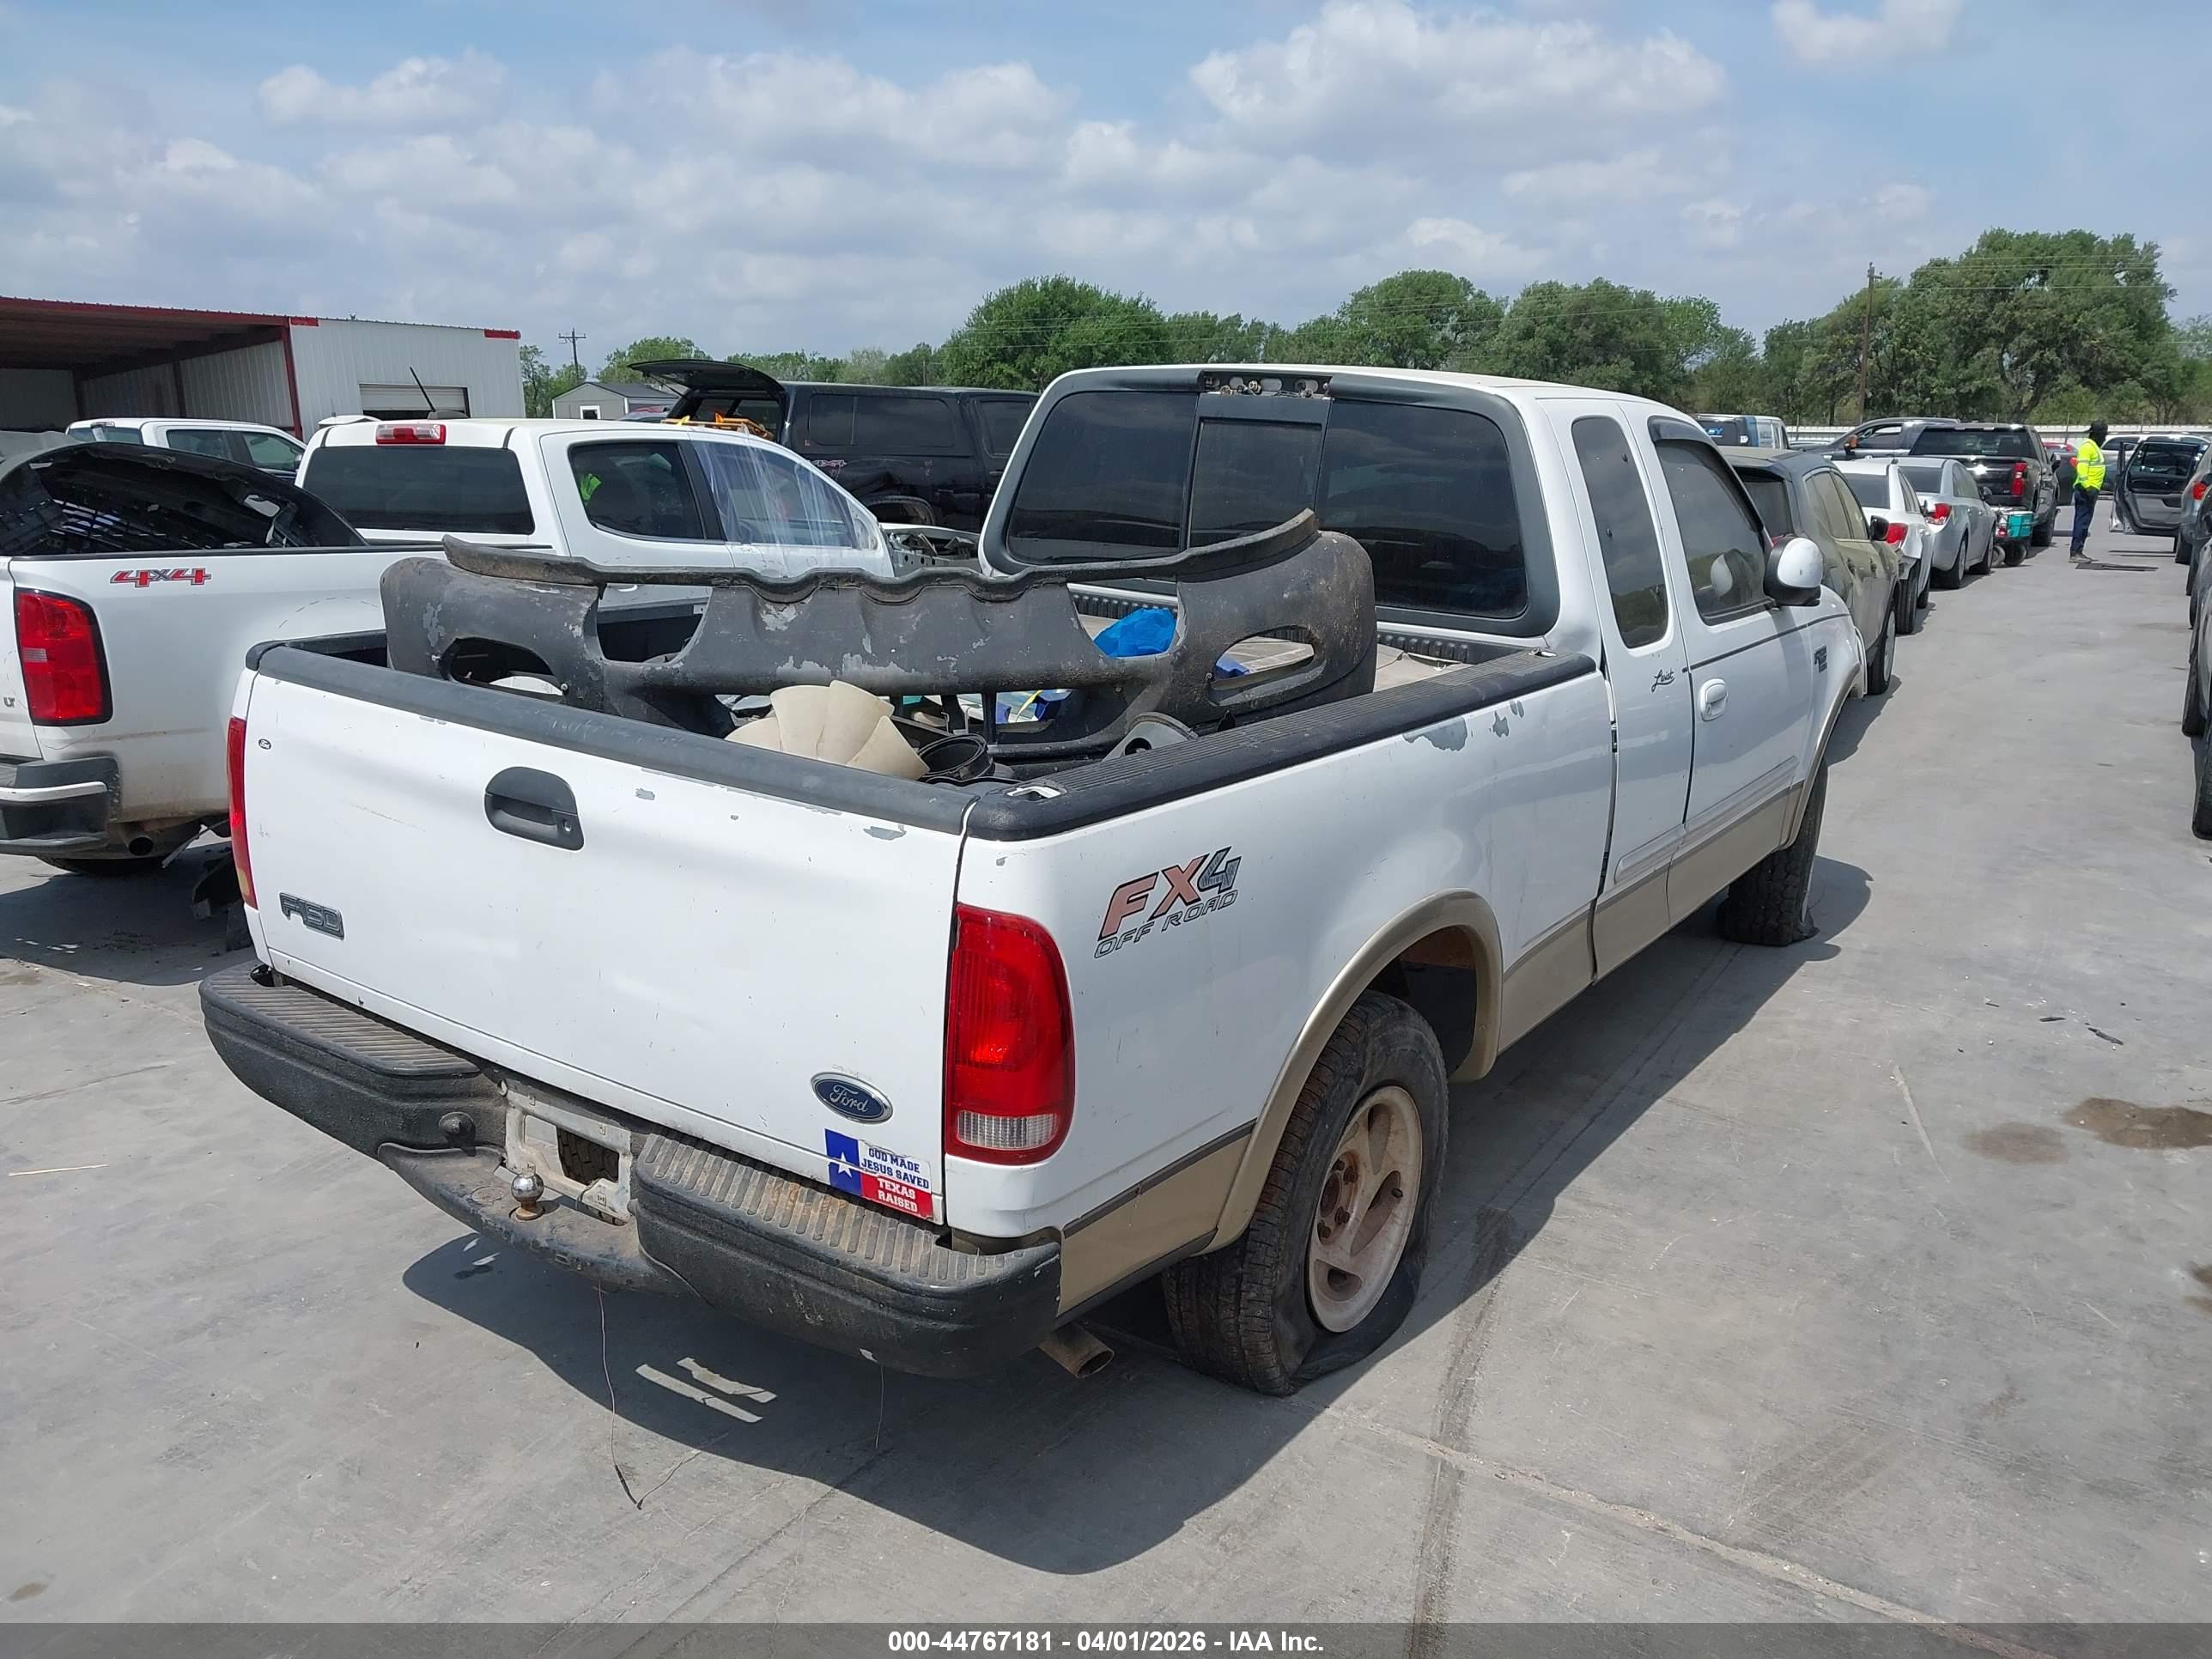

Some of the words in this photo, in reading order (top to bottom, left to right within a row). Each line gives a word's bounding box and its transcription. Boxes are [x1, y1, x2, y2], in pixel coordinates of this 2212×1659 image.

[1097, 846, 1242, 941] FX4
[1094, 921, 1155, 959] OFF
[1161, 890, 1238, 932] ROAD
[829, 1085, 869, 1113] Ford
[861, 1158, 893, 1177] JESUS
[896, 1170, 929, 1189] SAVED
[868, 1147, 888, 1162] GOD
[890, 1153, 921, 1174] MADE
[877, 1177, 916, 1200] TEXAS
[878, 1190, 918, 1212] RAISED
